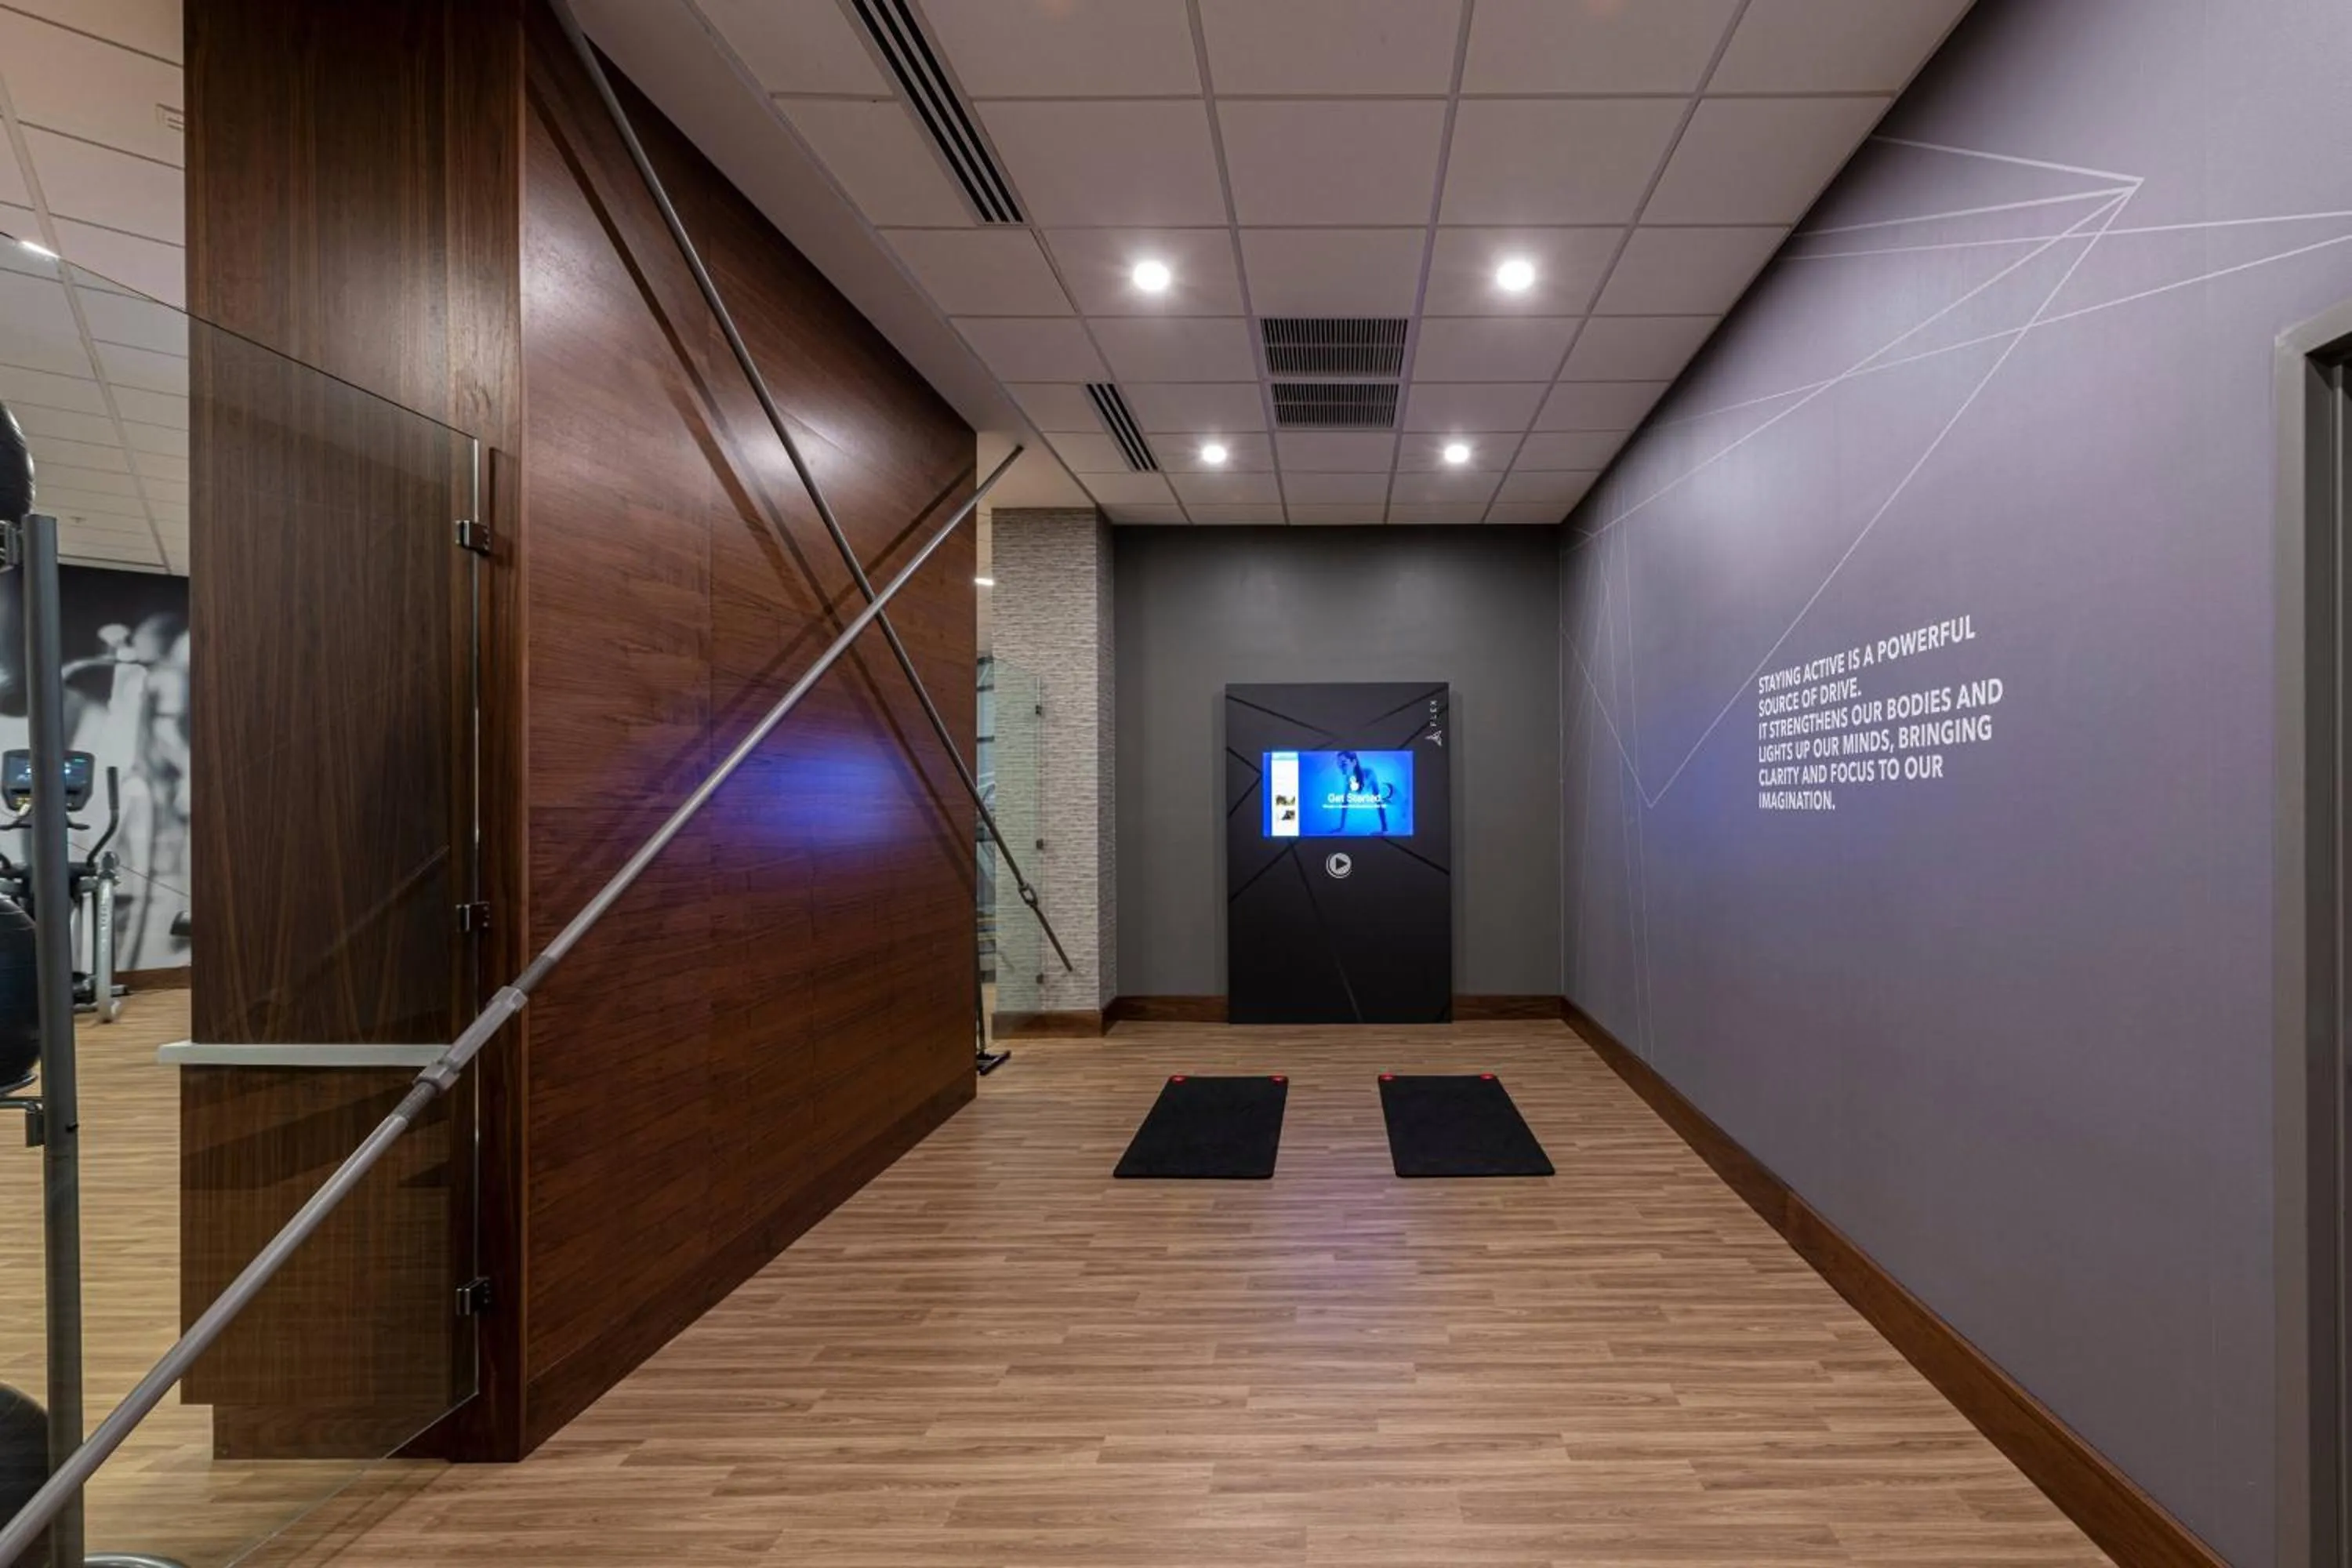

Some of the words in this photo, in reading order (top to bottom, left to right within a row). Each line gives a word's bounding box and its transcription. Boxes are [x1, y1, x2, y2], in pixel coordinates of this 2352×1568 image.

[1759, 666, 1801, 695] STAYING
[1803, 653, 1845, 681] ACTIVE
[1848, 648, 1860, 670] IS
[1864, 644, 1874, 666] A
[1878, 615, 1976, 662] POWERFUL
[1759, 692, 1799, 717] SOURCE
[1802, 688, 1817, 708] OF
[1820, 677, 1861, 705] DRIVE.
[1759, 722, 1768, 740] IT
[1769, 707, 1848, 738] STRENGTHENS
[1851, 701, 1882, 726] OUR
[1887, 688, 1951, 720] BODIES
[1956, 678, 2004, 709] AND
[1759, 741, 1793, 763] LIGHTS
[1795, 739, 1810, 760] UP
[1813, 736, 1839, 758] OUR
[1843, 729, 1895, 753] MINDS,
[1899, 715, 1992, 749] BRINGING
[1759, 763, 1799, 786] CLARITY
[1802, 763, 1827, 785] AND
[1830, 760, 1875, 783] FOCUS
[1878, 759, 1900, 781] TO
[1904, 755, 1944, 779] OUR
[1759, 790, 1835, 811] IMAGINATION.
